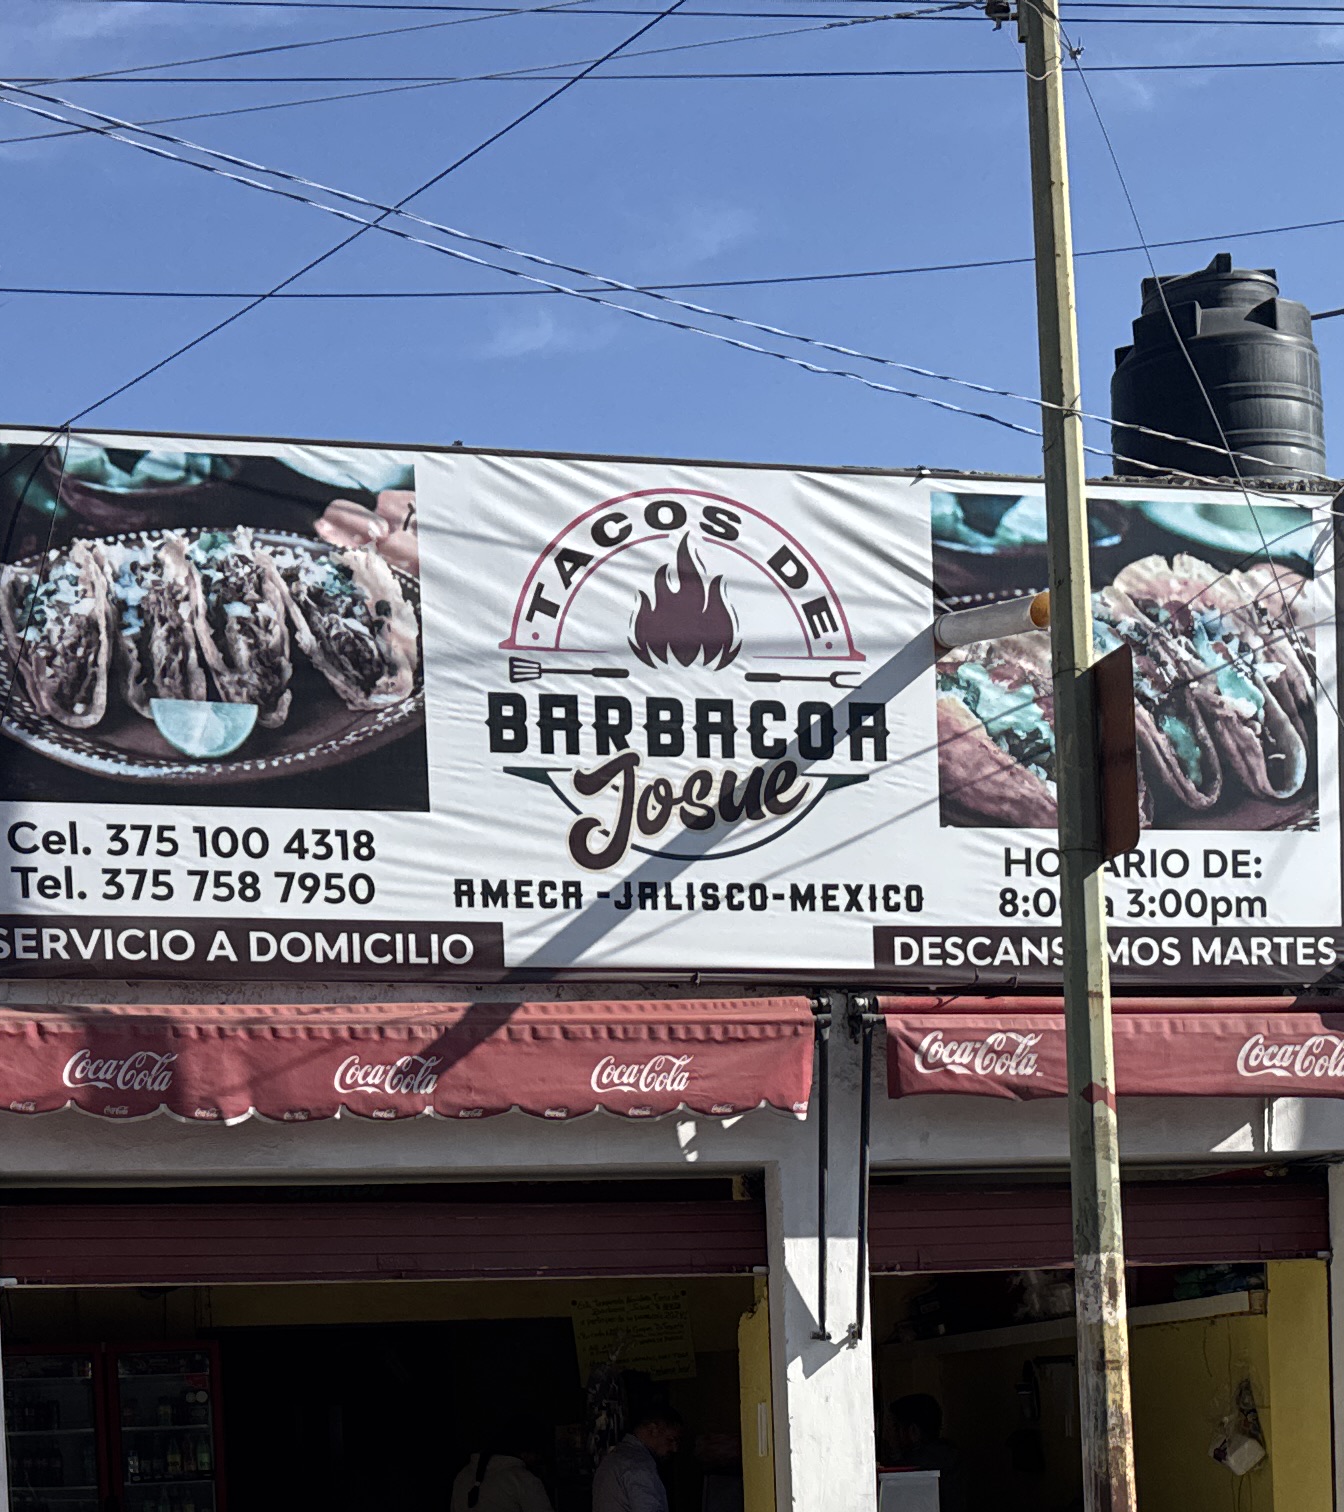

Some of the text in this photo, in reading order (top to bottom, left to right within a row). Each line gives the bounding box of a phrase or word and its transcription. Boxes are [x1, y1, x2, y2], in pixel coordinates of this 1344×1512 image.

[525, 500, 838, 640] TACOS DE
[485, 692, 890, 762] BARBACOA
[568, 749, 811, 870] Josue
[7, 821, 376, 861] Cel. 375 100 4318
[1004, 847, 1263, 880] HOARIO DE:
[11, 866, 375, 905] Tel. 375 758 7950
[453, 878, 583, 911] AMECA
[999, 887, 1061, 918] 8:0
[1127, 888, 1268, 926] 3:00pm
[207, 931, 238, 962] A
[249, 931, 474, 966] DOMICILIO
[894, 936, 1336, 967] DESCANSMOS MARTES
[62, 1048, 179, 1092] Coca-Cola
[590, 1053, 694, 1094] Coca-Cola
[914, 1031, 1043, 1076] Coca-Cola
[334, 1053, 441, 1096] Coca-Cola
